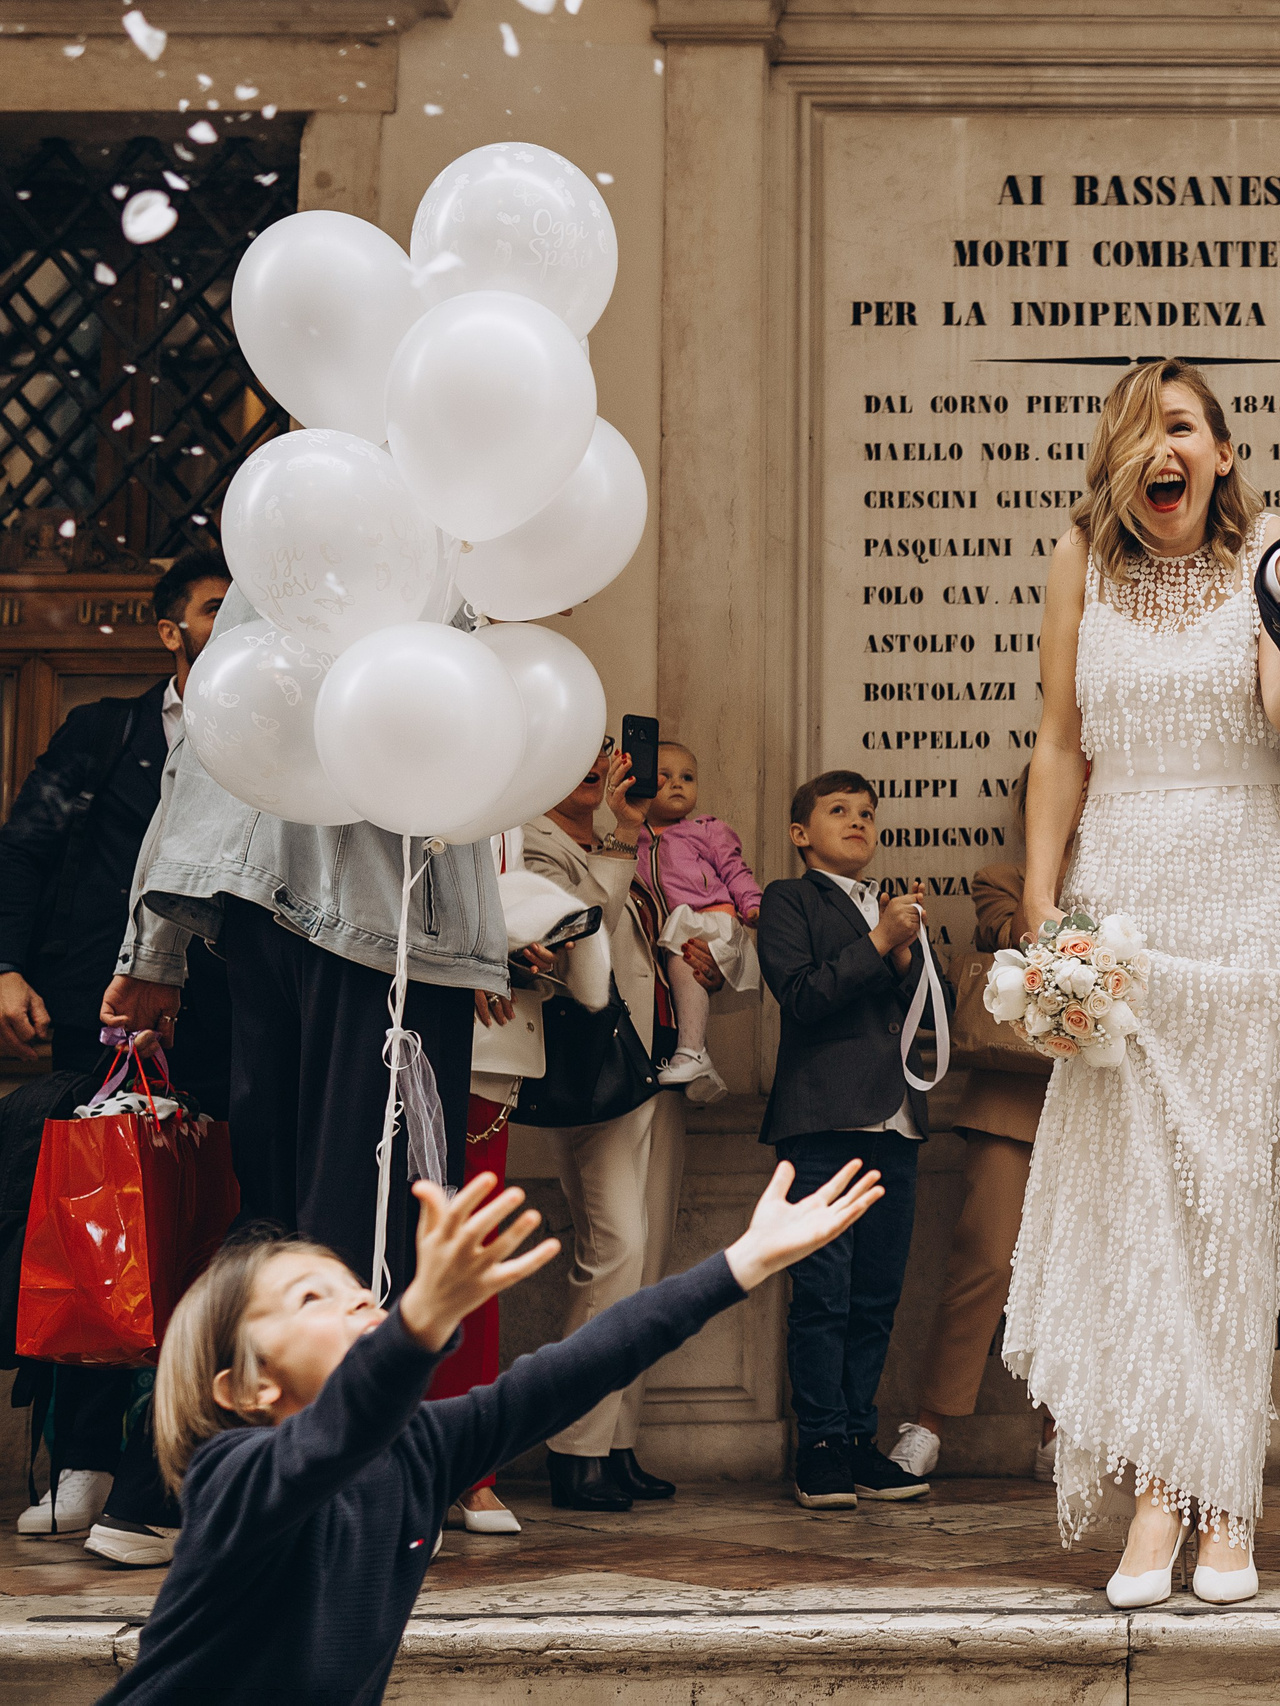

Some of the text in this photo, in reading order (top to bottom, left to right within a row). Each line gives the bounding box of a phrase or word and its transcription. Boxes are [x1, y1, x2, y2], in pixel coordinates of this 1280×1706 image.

[997, 174, 1044, 206] AI
[532, 208, 589, 248] Oggi
[523, 238, 592, 281] Sposi
[952, 239, 1069, 268] MORTI
[850, 300, 919, 327] PER
[941, 301, 988, 327] LA
[1010, 301, 1267, 327] INDIPENDENZA
[863, 394, 913, 414] DAL
[930, 394, 1009, 414] CORNO
[863, 442, 963, 461] MAELLO
[980, 442, 1040, 461] NOB.
[863, 490, 977, 509] CRESCINI
[863, 538, 1012, 565] PASQUALINI
[862, 586, 924, 605] FOLO
[942, 586, 999, 605] CAV.
[864, 634, 1041, 653] ASTOLFO LUI
[863, 682, 1016, 702] BORTOLAZZI
[862, 730, 991, 750] CAPPELLO
[875, 827, 1006, 848] ORDIGNON
